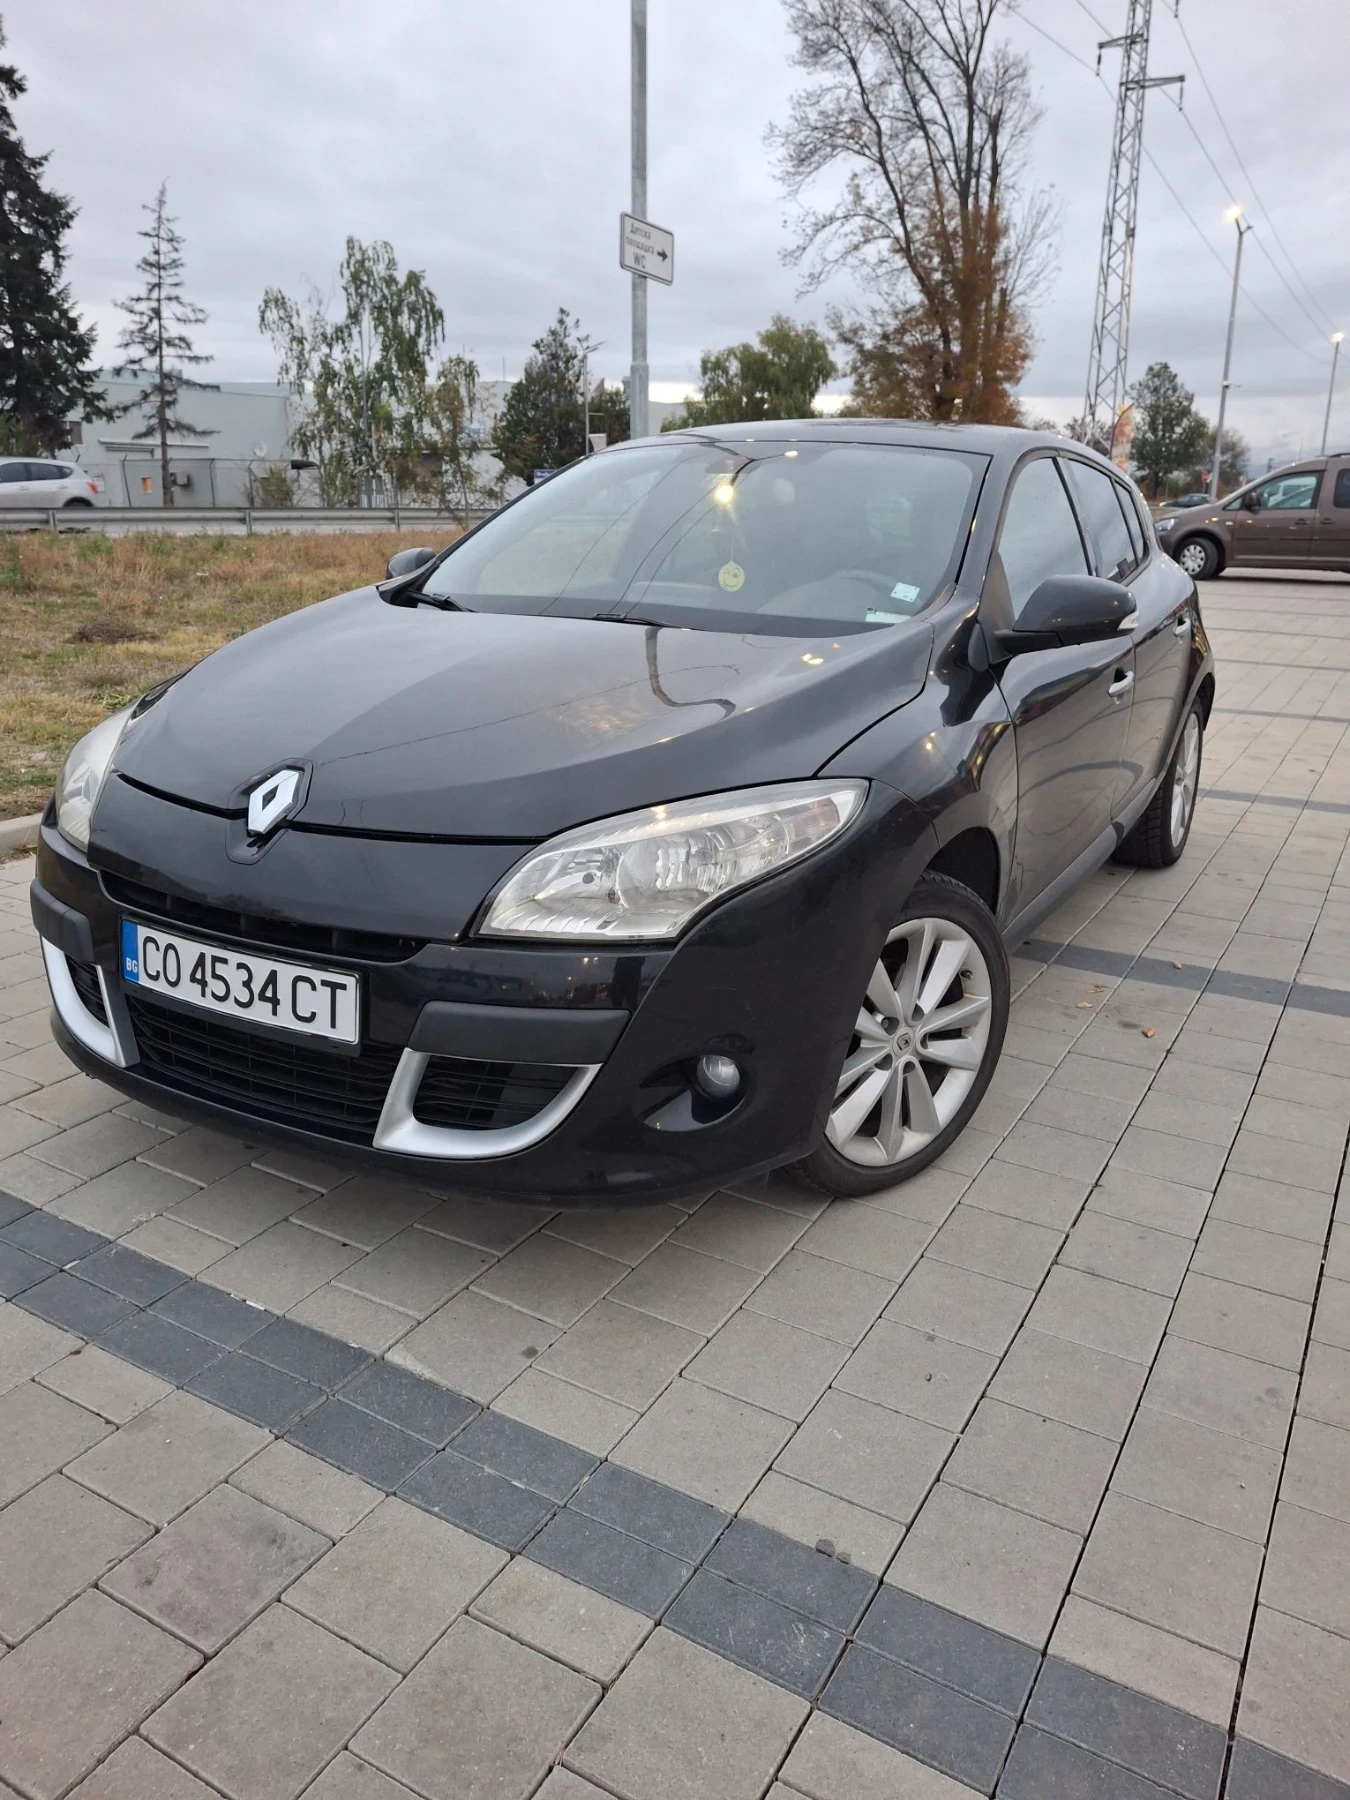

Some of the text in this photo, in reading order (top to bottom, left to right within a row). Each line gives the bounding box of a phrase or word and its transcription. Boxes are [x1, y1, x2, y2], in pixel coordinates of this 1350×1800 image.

[633, 251, 646, 269] WC
[125, 956, 138, 974] BG
[189, 951, 281, 1017] 4534
[291, 974, 348, 1029] CT
